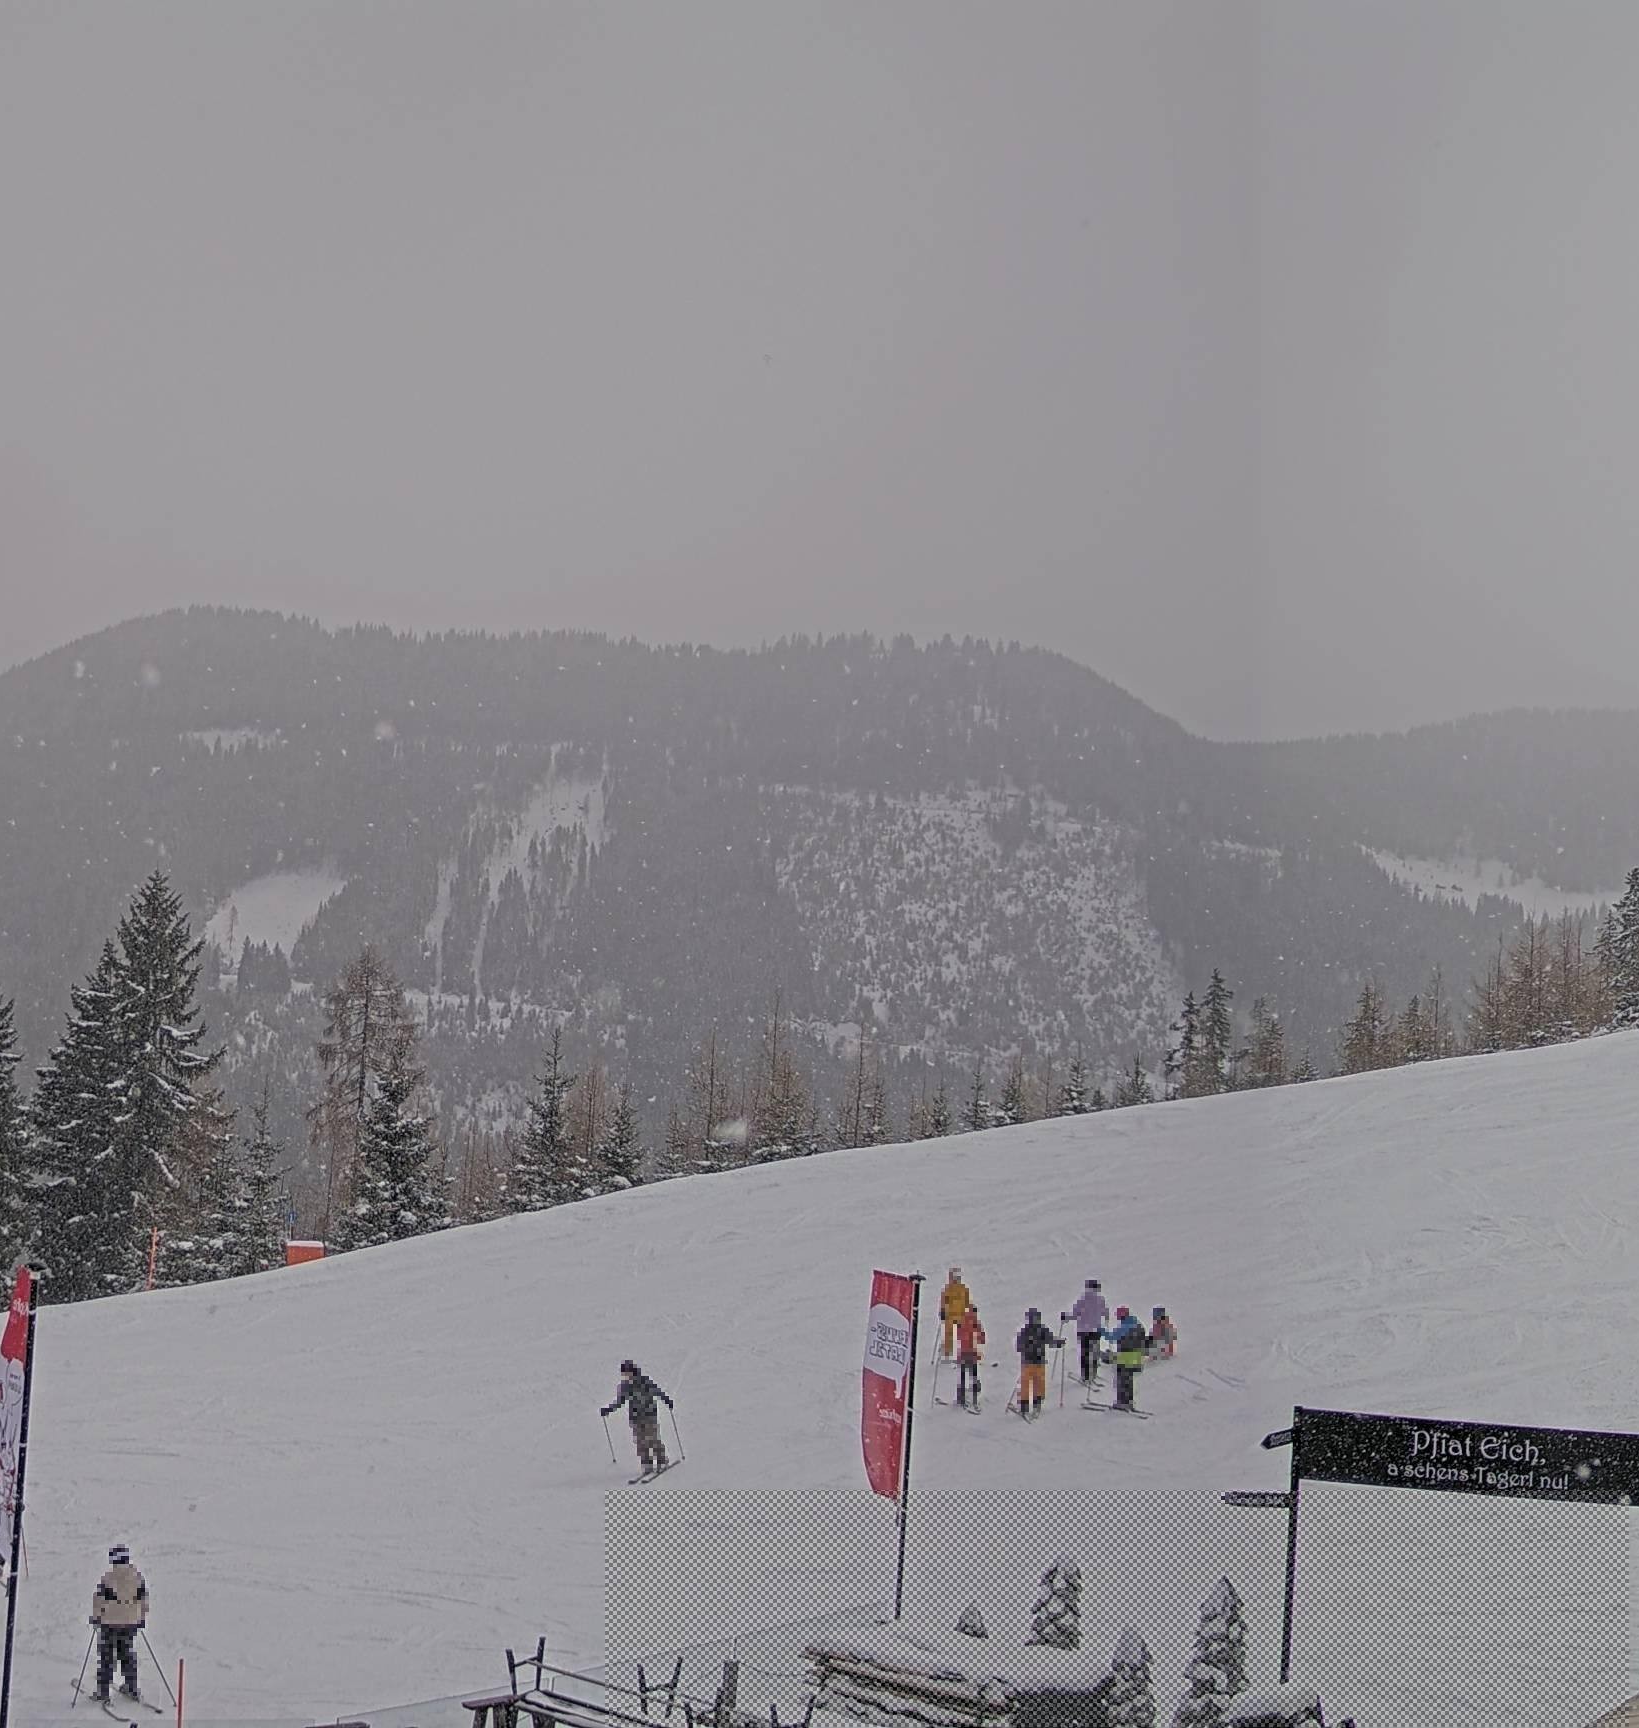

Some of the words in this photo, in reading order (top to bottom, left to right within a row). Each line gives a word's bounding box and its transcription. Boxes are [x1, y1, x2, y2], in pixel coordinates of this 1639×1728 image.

[1410, 1430, 1471, 1460] Pfiat
[1480, 1436, 1546, 1466] Eich,
[1540, 1474, 1569, 1490] nu!
